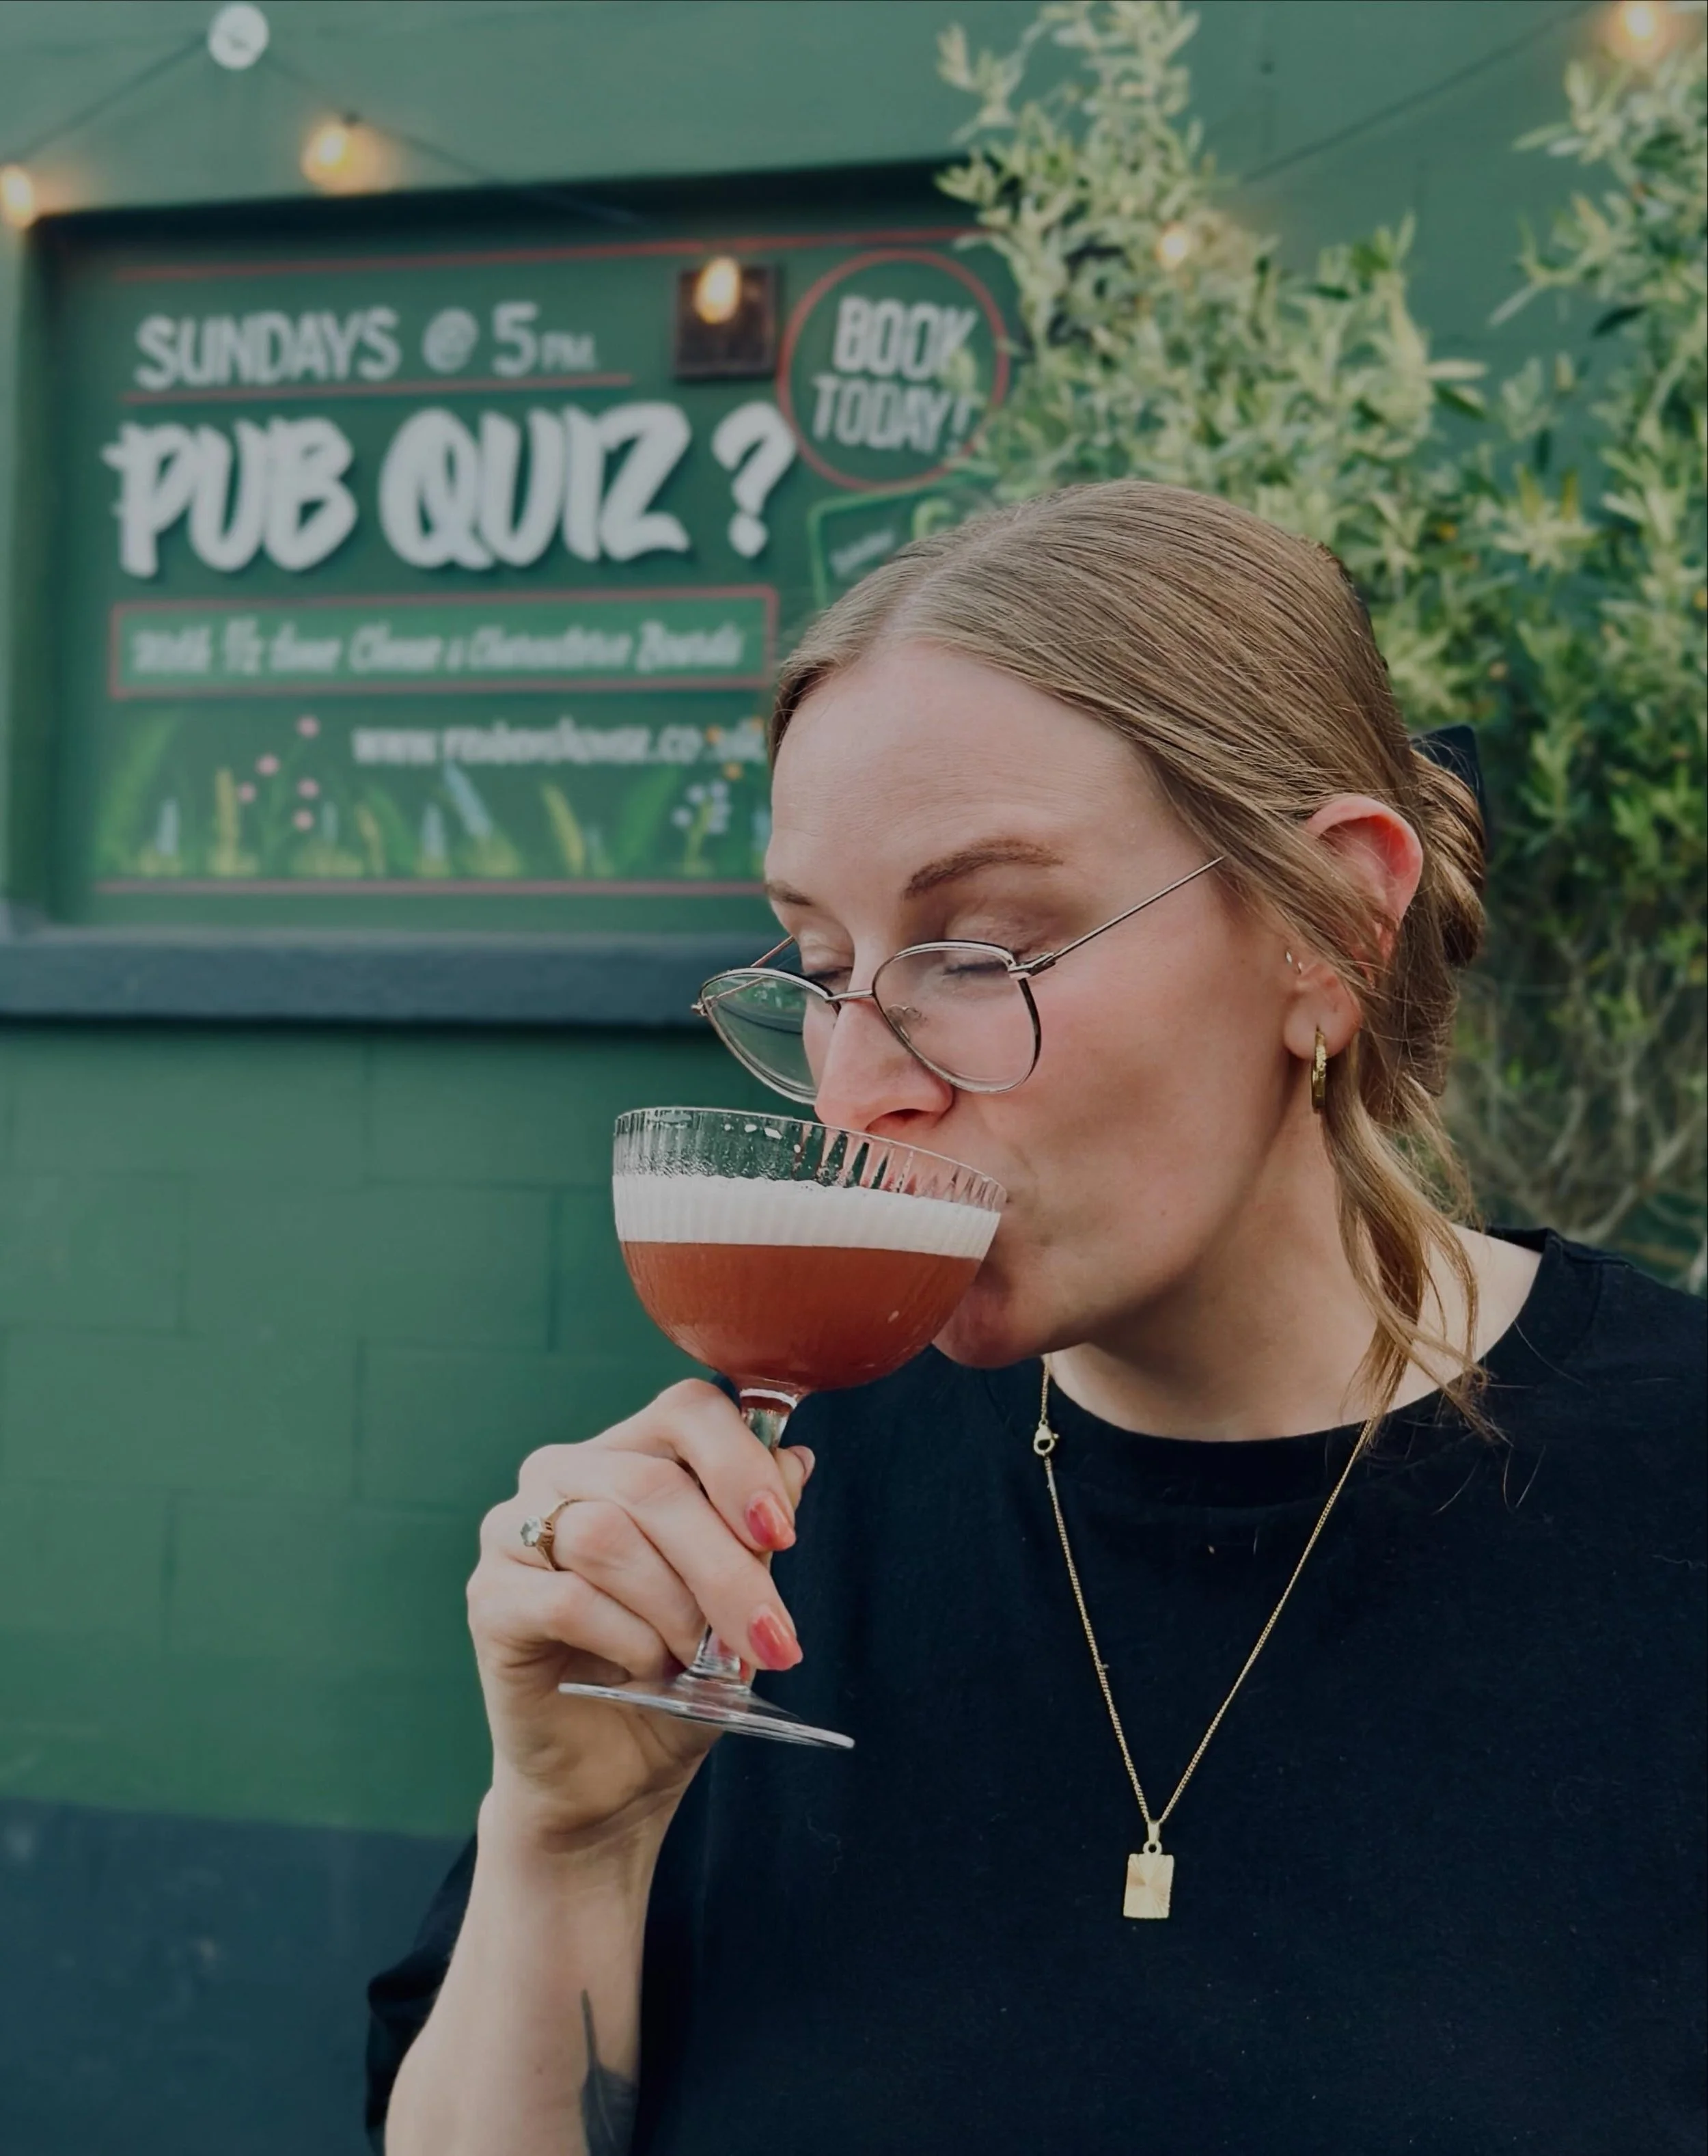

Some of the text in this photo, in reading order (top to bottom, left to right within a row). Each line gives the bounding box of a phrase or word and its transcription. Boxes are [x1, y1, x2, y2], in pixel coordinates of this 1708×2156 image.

[135, 306, 401, 390] SUNDAYS
[422, 308, 478, 373] @
[833, 296, 976, 380] BOOK
[811, 373, 973, 453] TODAY!
[103, 415, 357, 577] PUB
[378, 405, 690, 569] QUIZ
